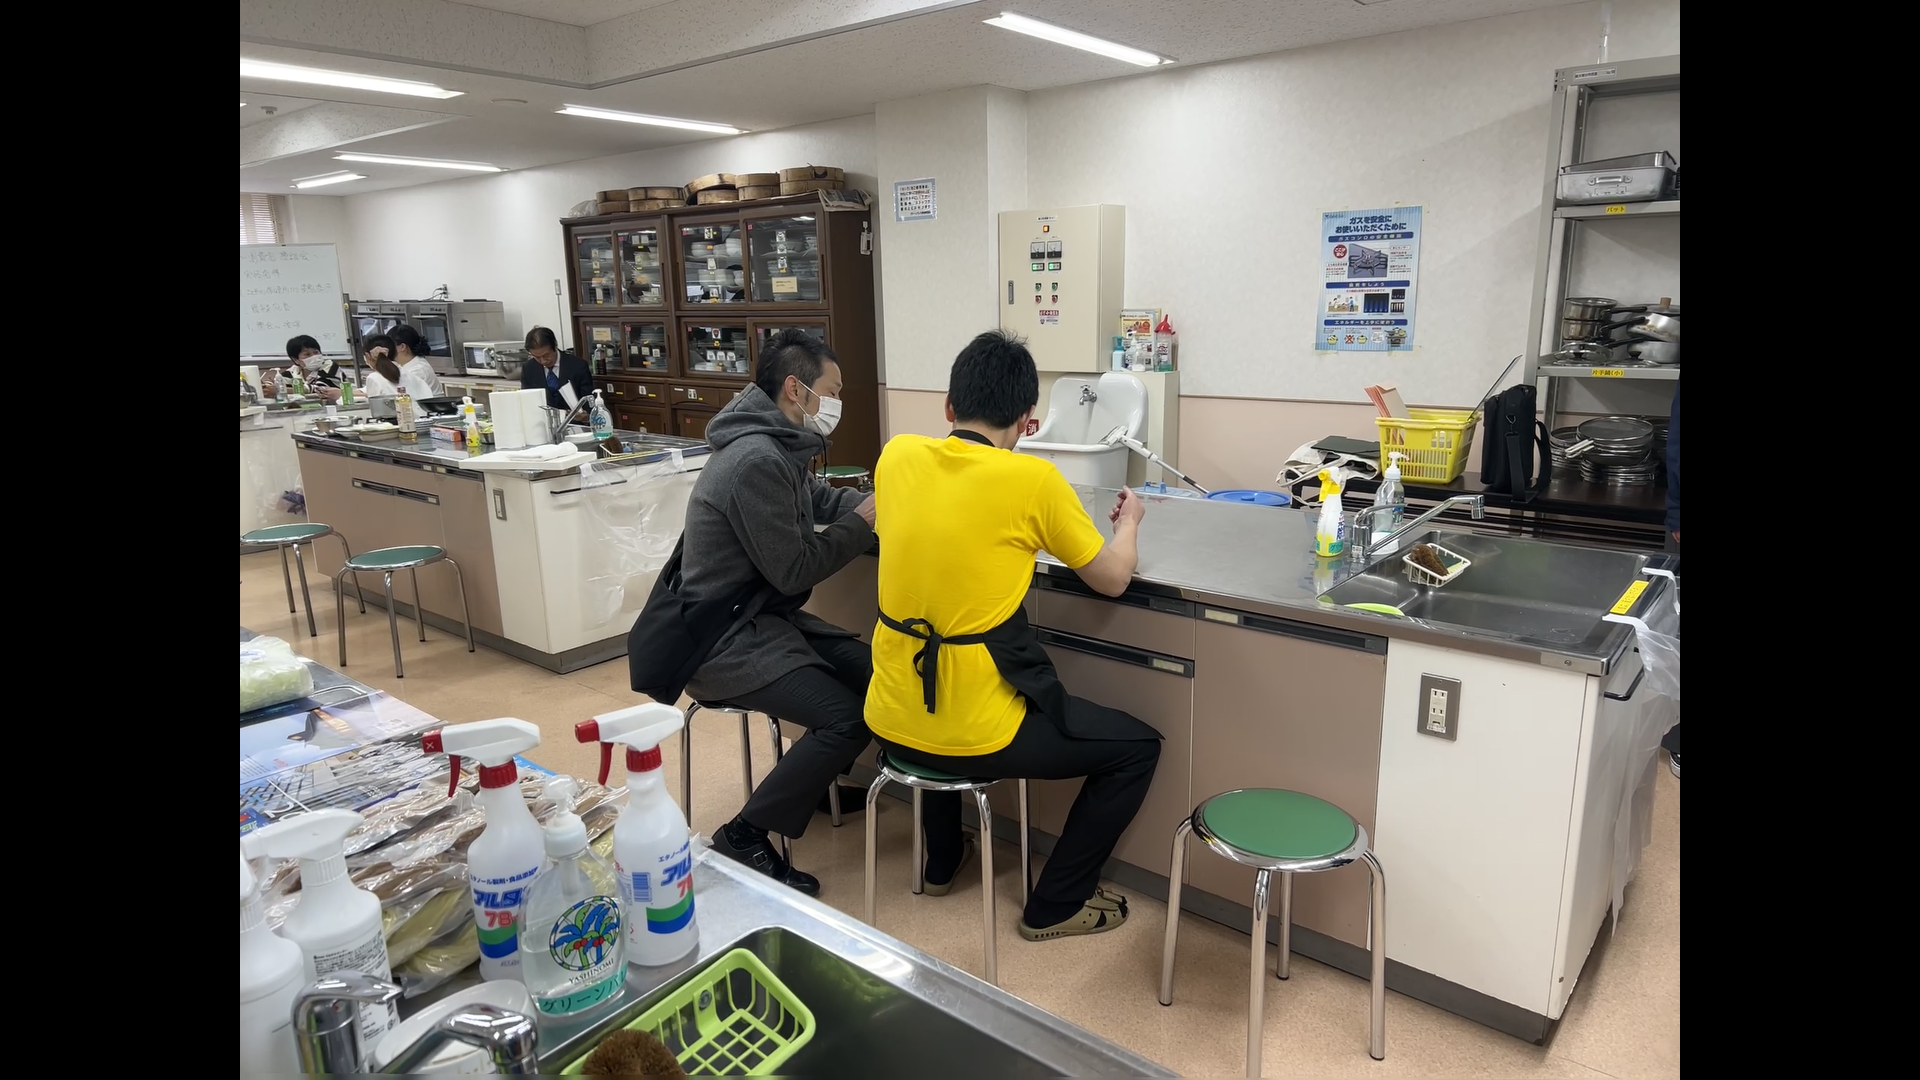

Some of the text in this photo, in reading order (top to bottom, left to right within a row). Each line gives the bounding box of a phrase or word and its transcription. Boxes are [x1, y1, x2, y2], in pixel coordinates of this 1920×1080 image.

[1349, 215, 1392, 225] ガスを安全に
[1335, 223, 1407, 234] お使いいただくために
[569, 958, 614, 984] YASHINOMI
